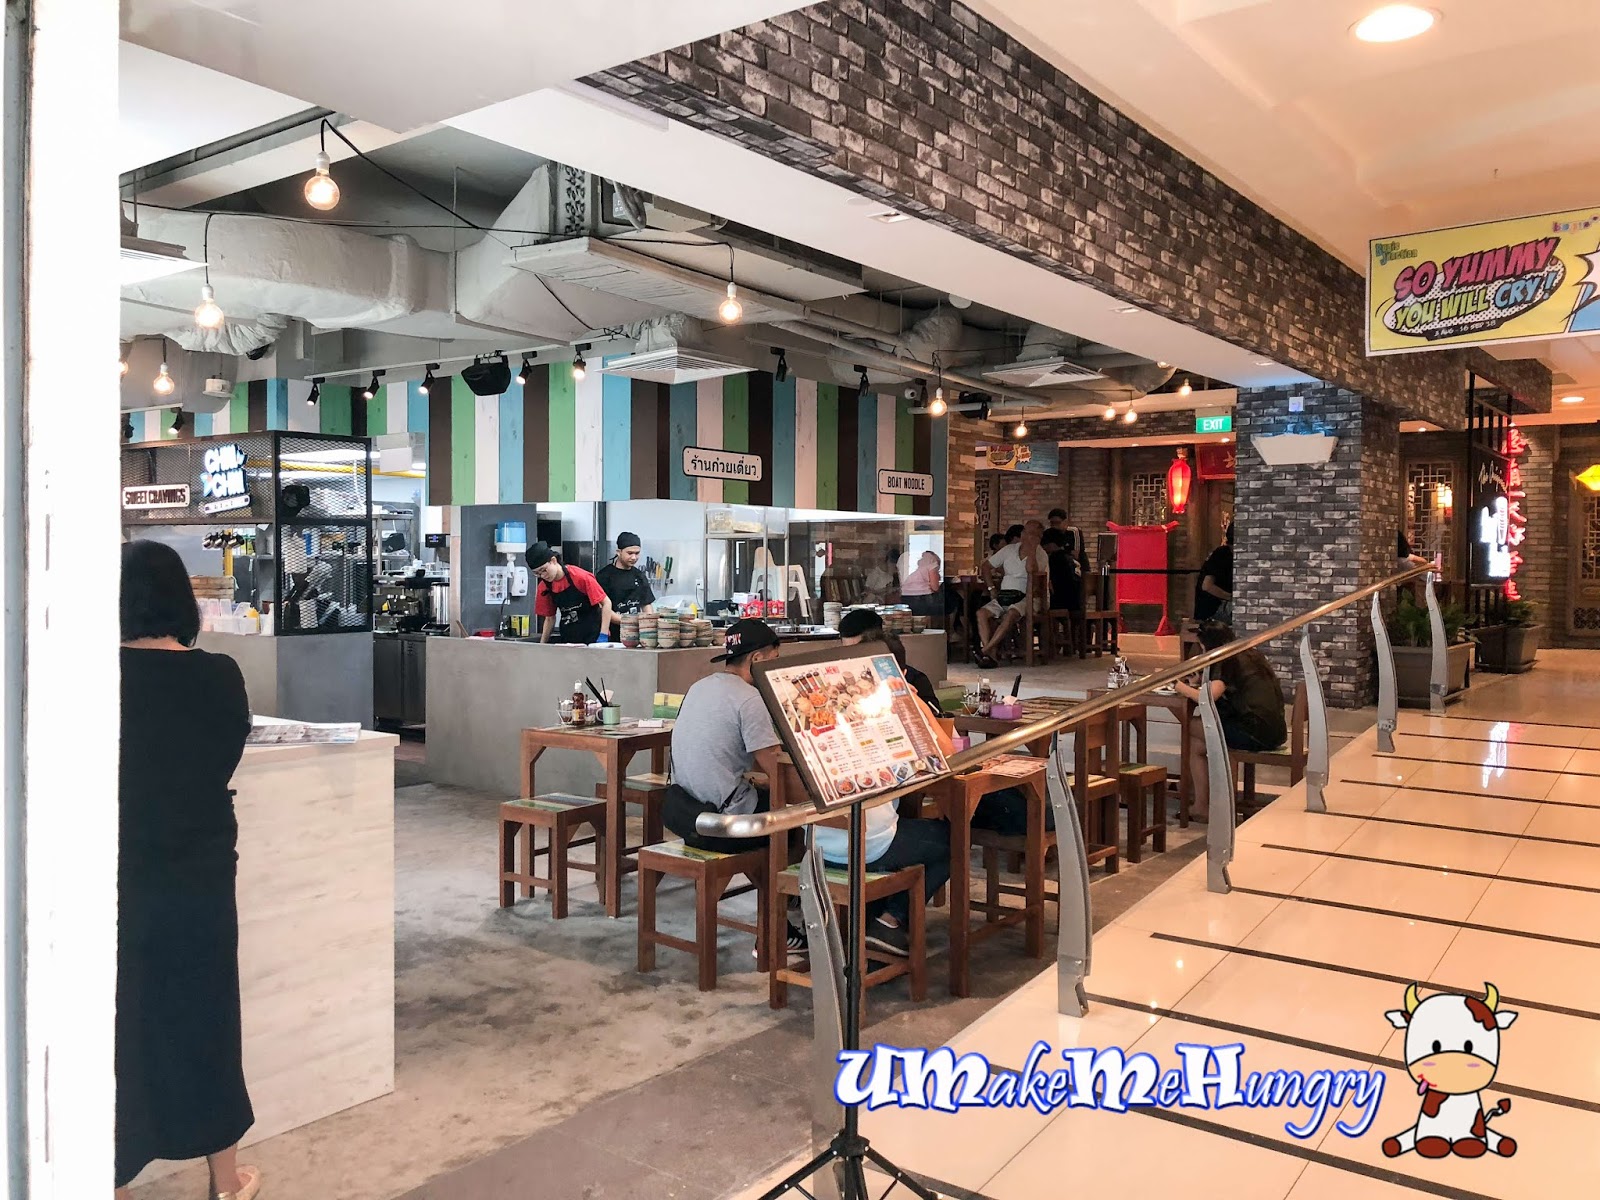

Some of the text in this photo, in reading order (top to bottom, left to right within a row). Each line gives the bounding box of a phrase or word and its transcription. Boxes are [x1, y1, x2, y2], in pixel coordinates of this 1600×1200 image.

[1394, 261, 1437, 301] SO
[1395, 299, 1437, 329] YOU
[1440, 286, 1489, 321] WILL
[1203, 418, 1224, 431] EXIT
[887, 476, 925, 490] BOAT NOODLE
[125, 488, 186, 505] SWEET CRAVINGS
